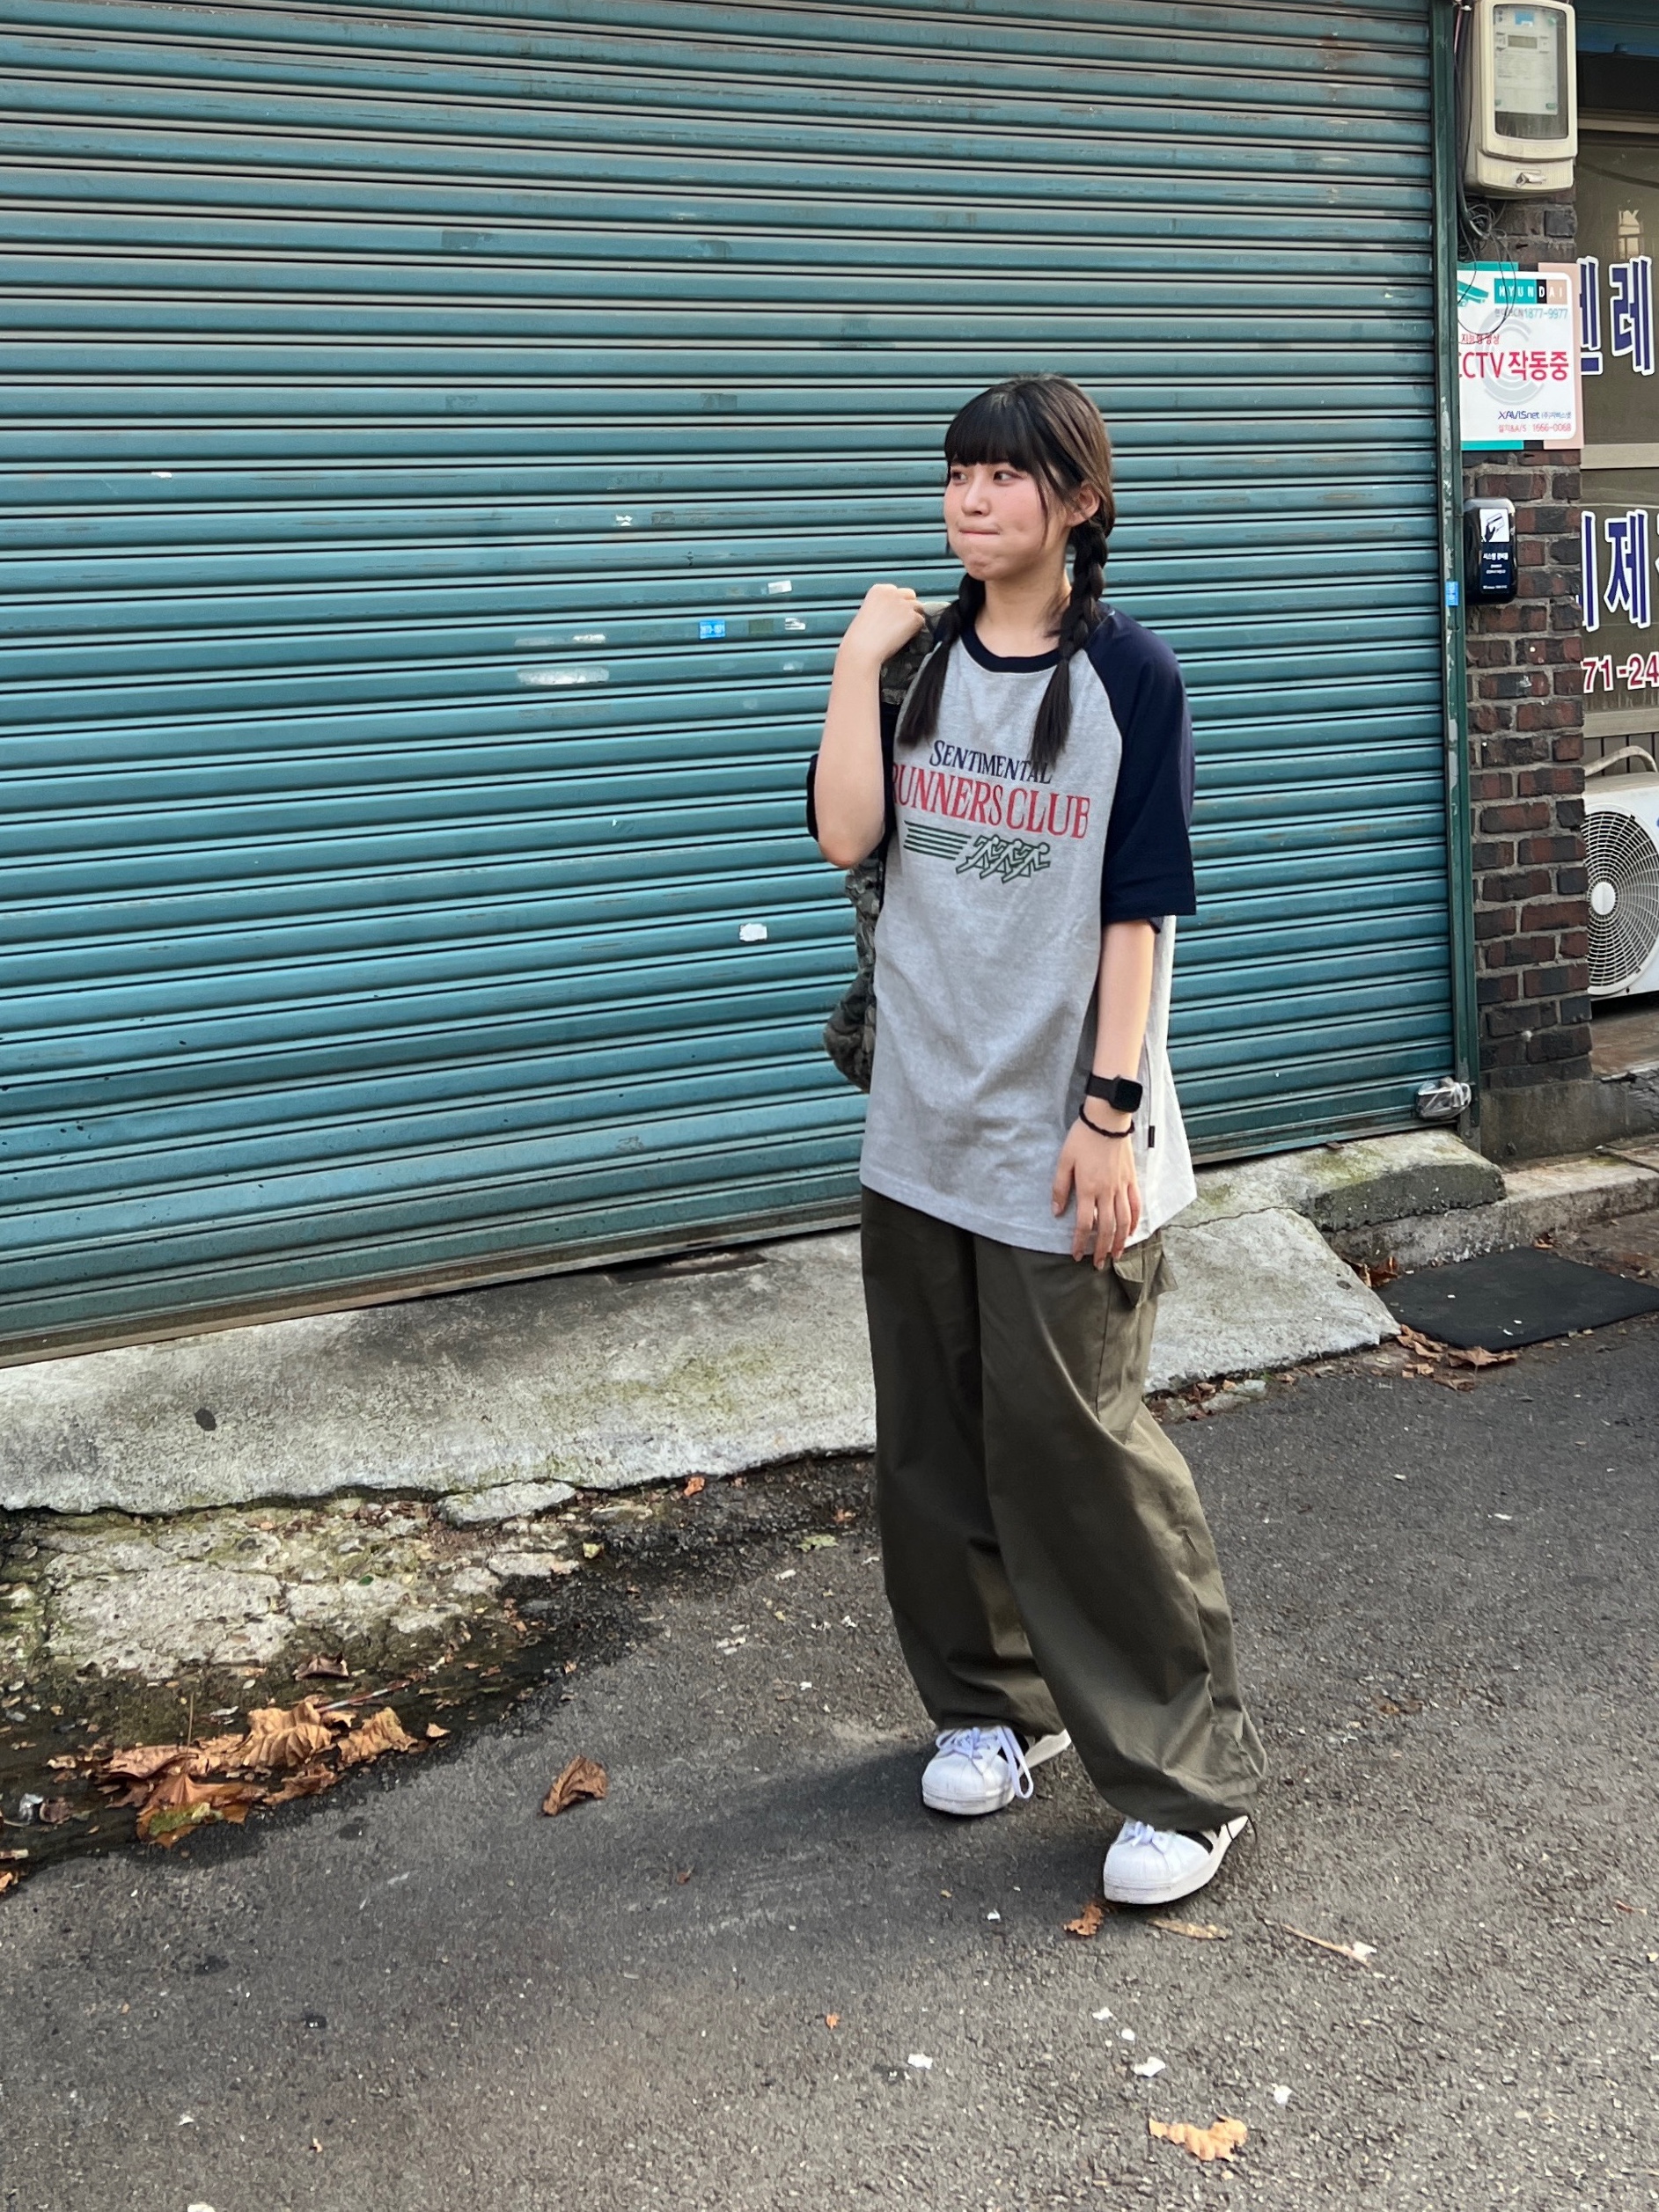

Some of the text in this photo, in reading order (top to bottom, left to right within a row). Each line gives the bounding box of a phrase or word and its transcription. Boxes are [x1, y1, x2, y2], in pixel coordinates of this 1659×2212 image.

[1498, 285, 1563, 298] HYUNDAI
[1524, 308, 1568, 319] 1877-9977
[1458, 351, 1505, 379] CTV
[929, 739, 1053, 785] SENTIMENTAL
[1006, 787, 1091, 839] CLUB
